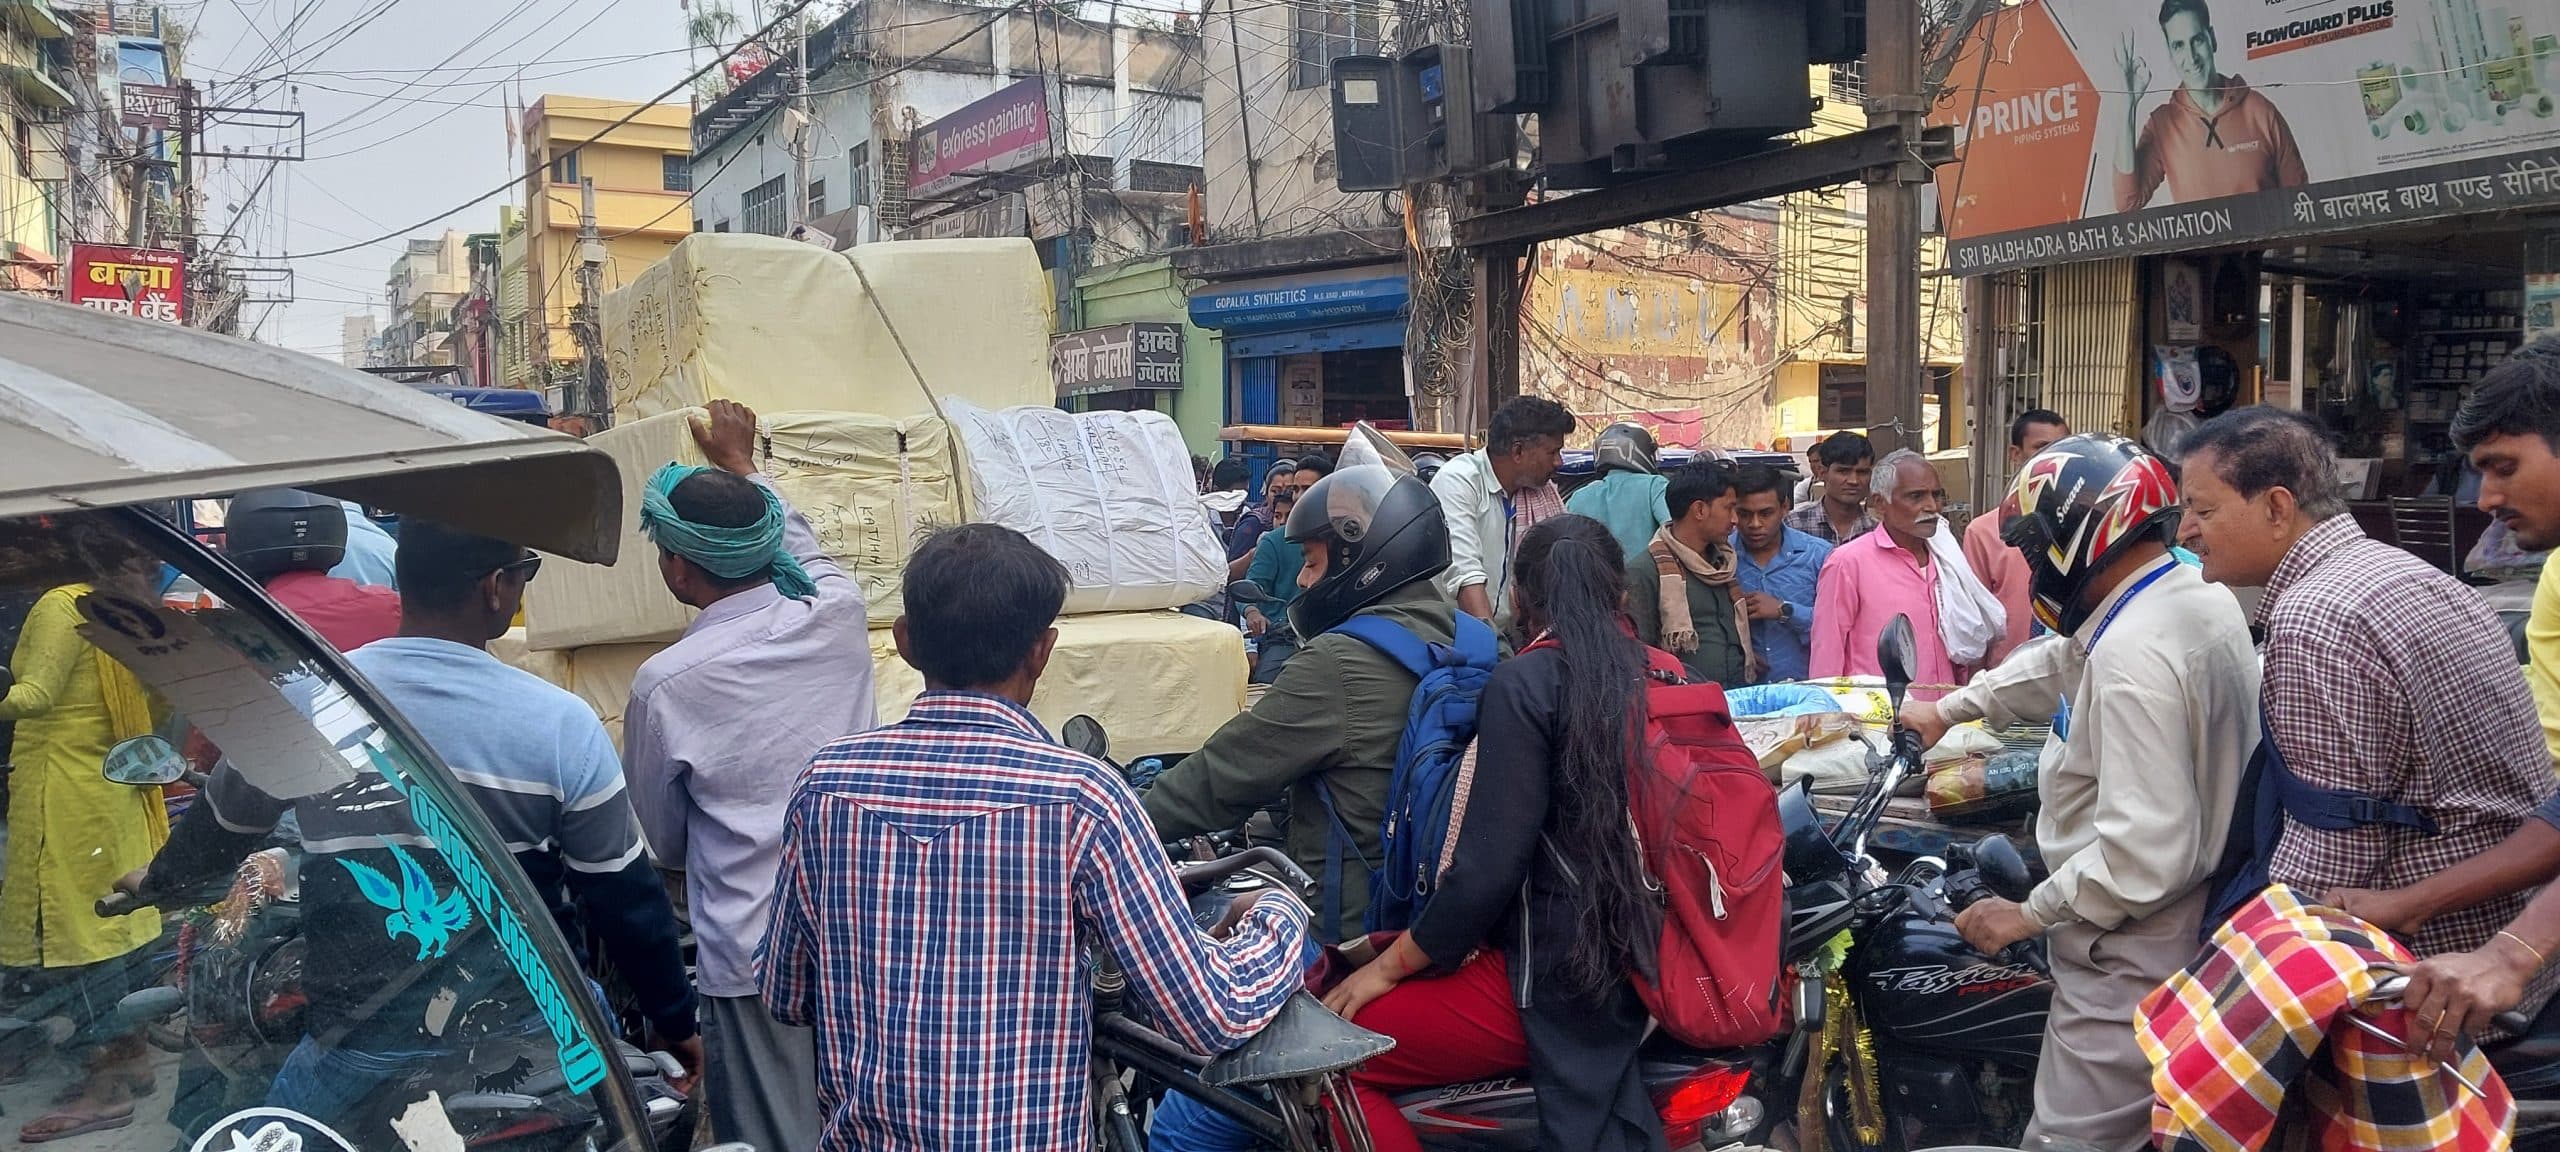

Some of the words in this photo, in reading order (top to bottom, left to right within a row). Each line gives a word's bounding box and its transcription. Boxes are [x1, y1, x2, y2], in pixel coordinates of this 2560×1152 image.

[124, 85, 143, 95] THE
[1976, 82, 2079, 139] PRINCE
[942, 126, 986, 160] express
[987, 100, 1037, 147] painting
[2014, 129, 2042, 145] PIPING
[2043, 121, 2080, 139] SYSTEMS
[2293, 191, 2317, 224] श्री
[2320, 189, 2391, 220] बालभद्र
[2395, 182, 2440, 210] बाथ
[2443, 175, 2494, 209] एण्ड
[1960, 248, 1980, 269] SRI
[1983, 233, 2065, 266] BALBHADRA
[2067, 228, 2108, 253] BATH
[2111, 224, 2125, 246] &
[2127, 207, 2233, 246] SANITATION
[139, 292, 178, 323] बैंड
[1215, 294, 1250, 309] GOPALKA
[1253, 289, 1307, 306] SYNTHETICS
[1138, 325, 1179, 354] अम्बे
[1988, 768, 1999, 776] AN
